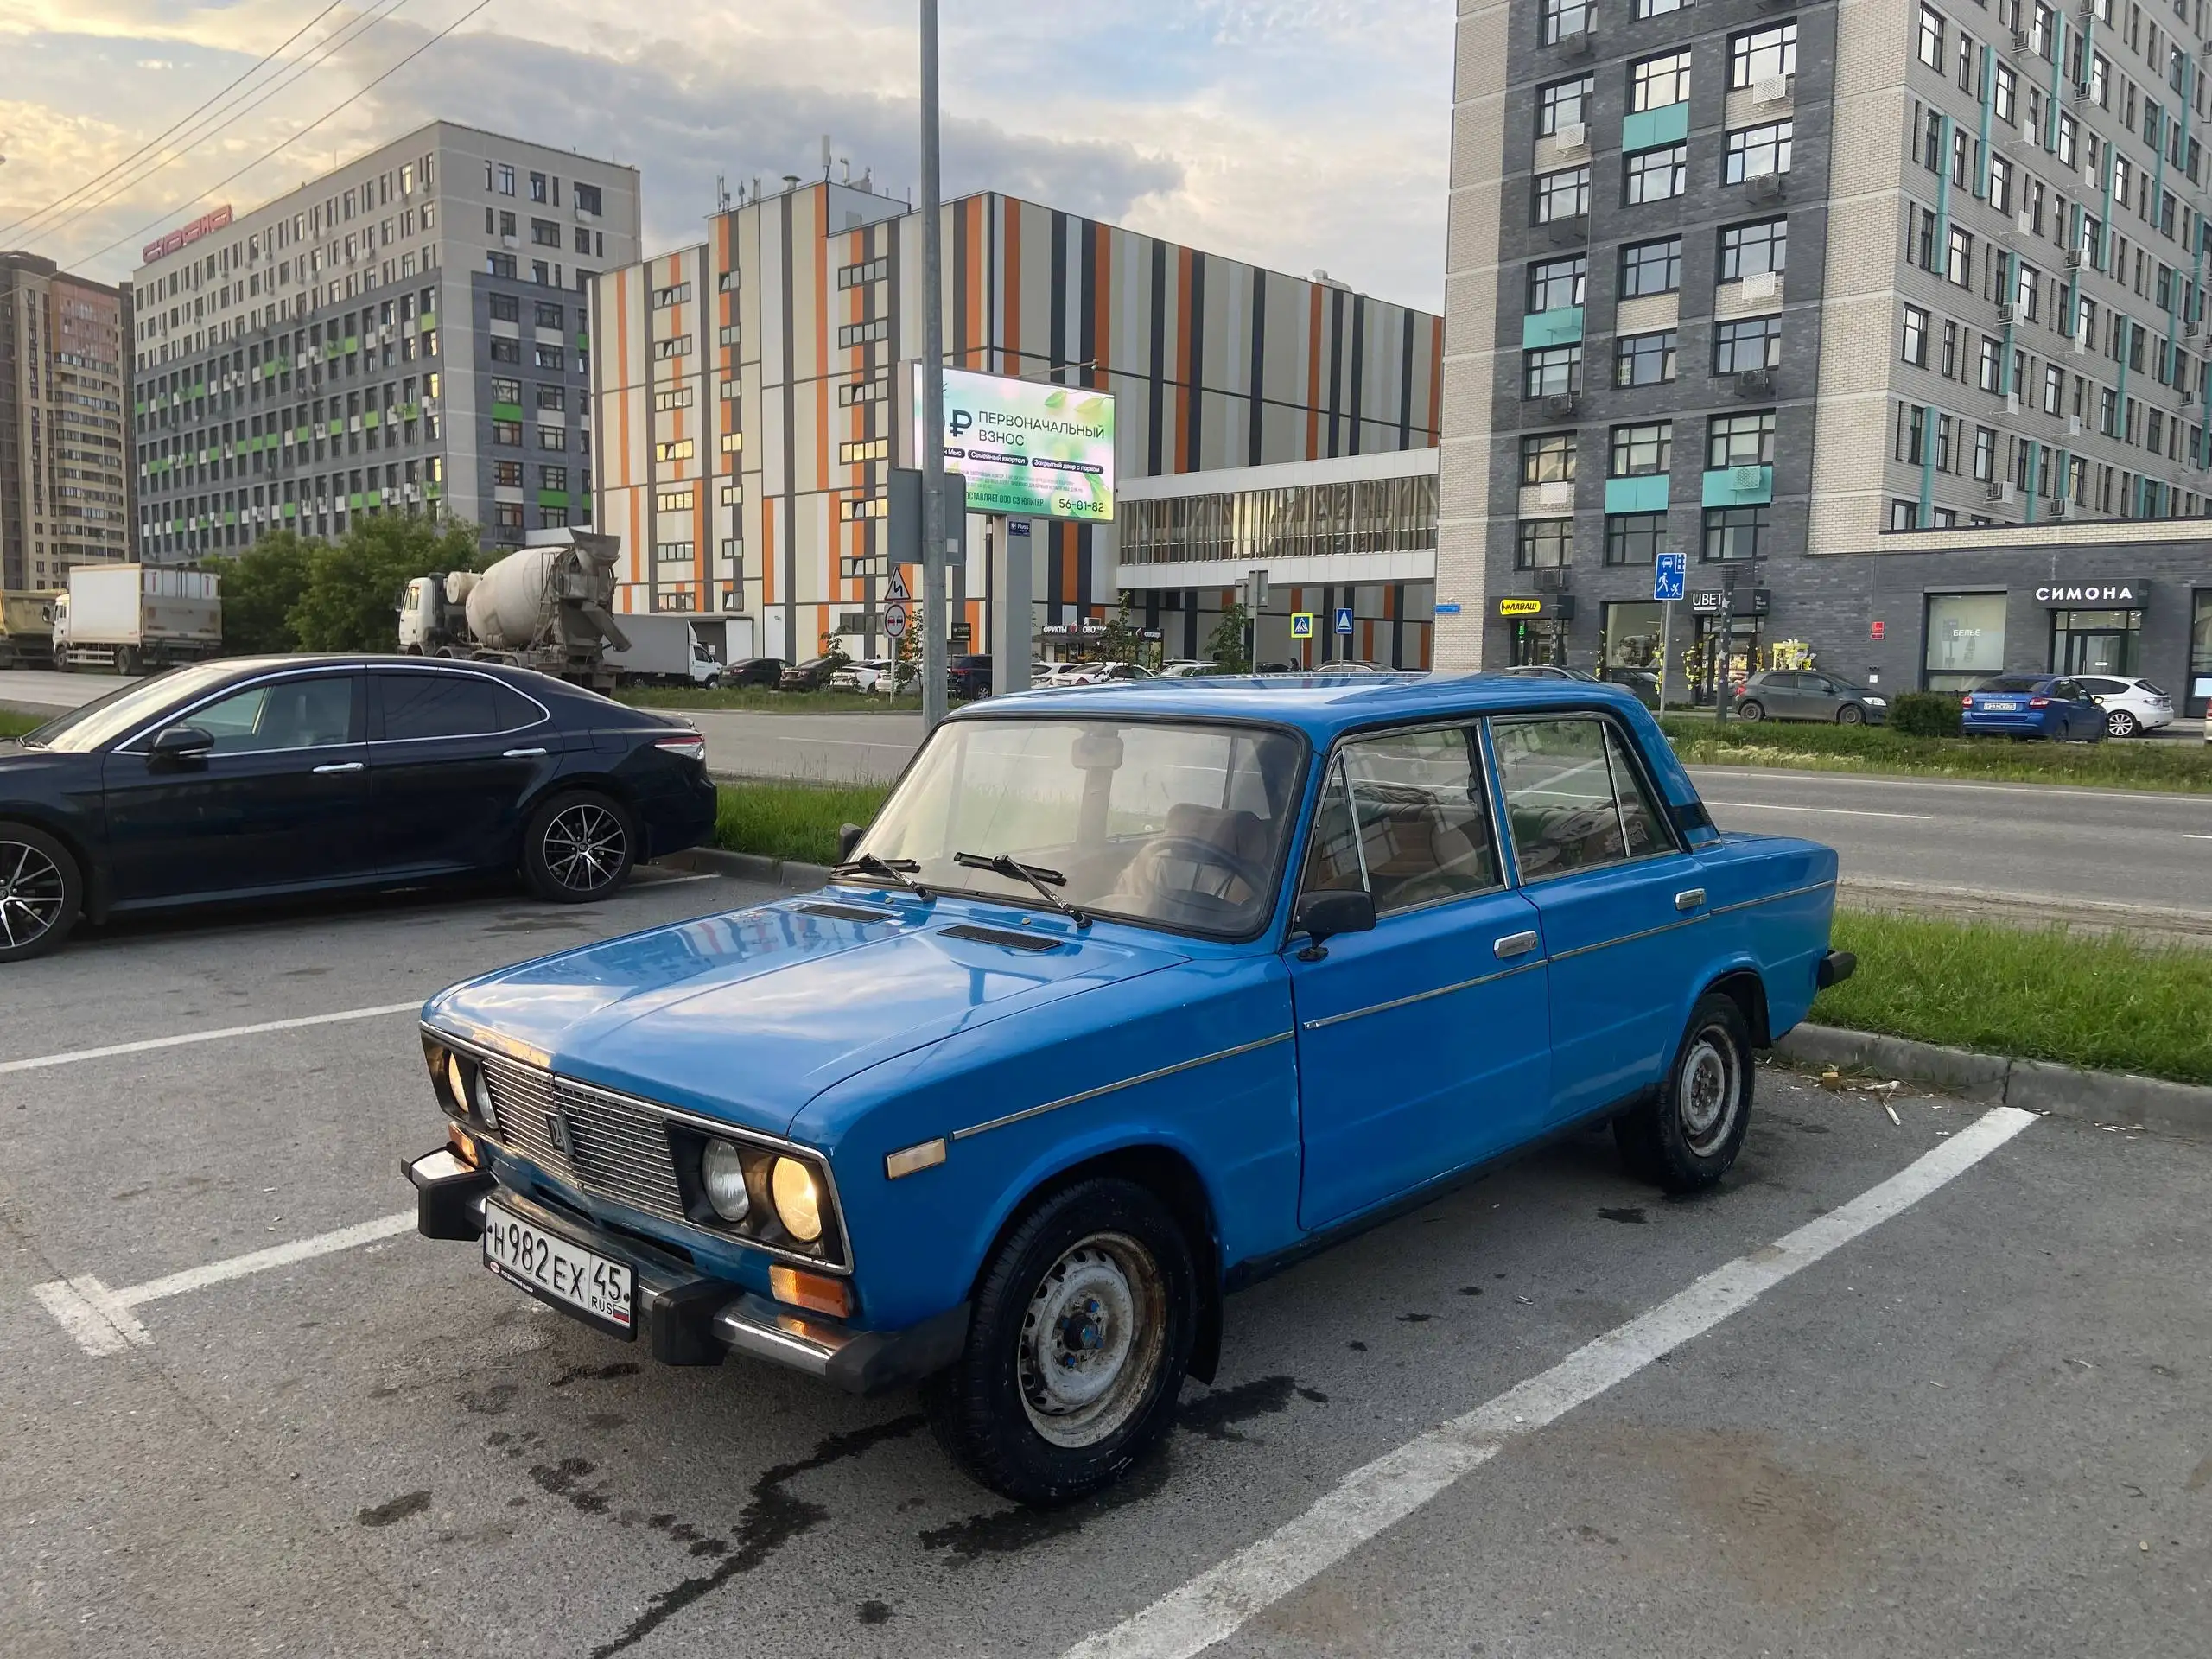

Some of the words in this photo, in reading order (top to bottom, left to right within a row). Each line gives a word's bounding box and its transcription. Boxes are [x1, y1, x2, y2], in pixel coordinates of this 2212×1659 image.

[978, 410, 1105, 439] ПЕРВОНАЧАЛЬНЫЙ
[978, 429, 1025, 446] ВЗНОС
[970, 451, 1002, 461] Семейный
[1033, 459, 1063, 467] Закрытый
[1021, 497, 1044, 506] ЮПИТЕР
[1058, 499, 1104, 512] 56-81-82
[2036, 587, 2133, 601] СИМОНА
[493, 1222, 585, 1301] Н982ЕХ
[594, 1262, 622, 1301] 45
[591, 1296, 613, 1316] RUS
